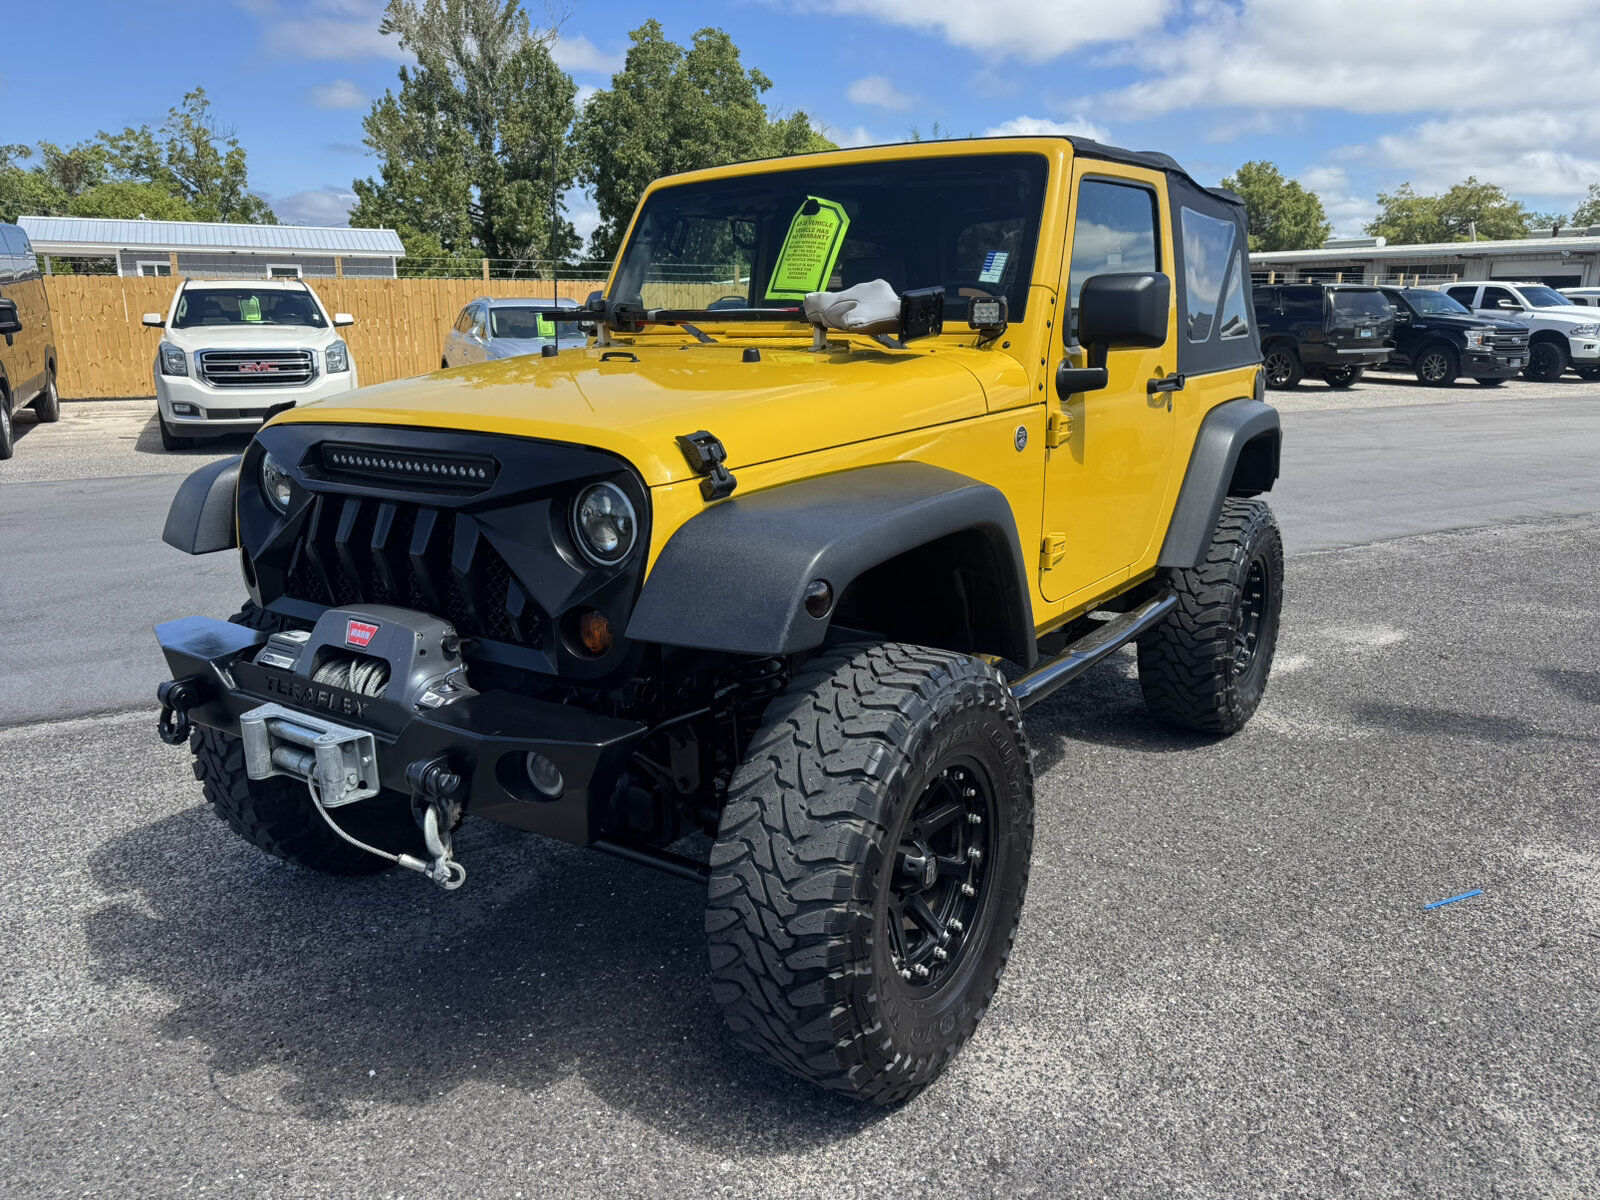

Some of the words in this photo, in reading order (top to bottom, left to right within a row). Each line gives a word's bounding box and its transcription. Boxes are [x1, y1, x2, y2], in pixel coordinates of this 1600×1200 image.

[808, 220, 833, 228] VEHICLE
[238, 361, 280, 373] GMC
[351, 628, 371, 640] WARN
[265, 676, 368, 718] TERAFLEX
